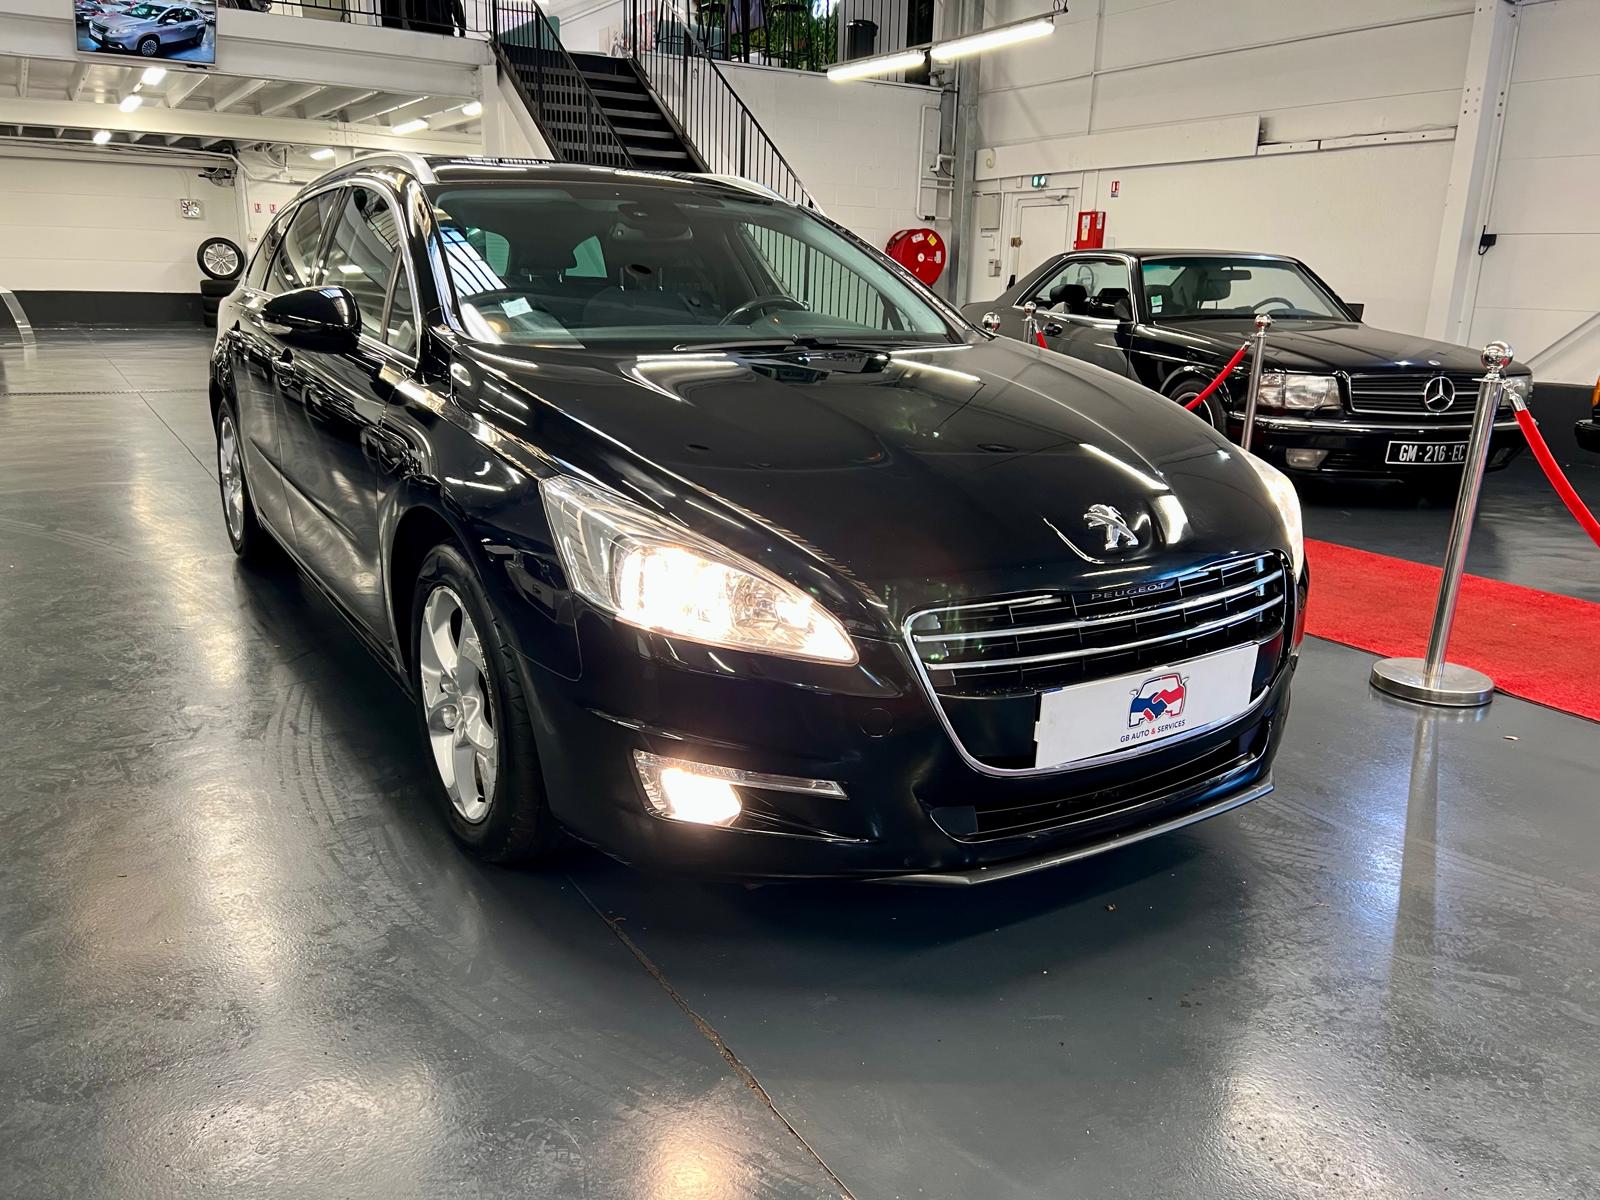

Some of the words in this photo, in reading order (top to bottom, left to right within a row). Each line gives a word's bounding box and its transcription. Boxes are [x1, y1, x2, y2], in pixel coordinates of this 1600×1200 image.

[1091, 581, 1167, 600] PEUGEOT
[1120, 734, 1130, 743] GB
[1131, 729, 1150, 740] AUTO
[1150, 727, 1156, 735] &
[1157, 719, 1186, 734] SERVICES
